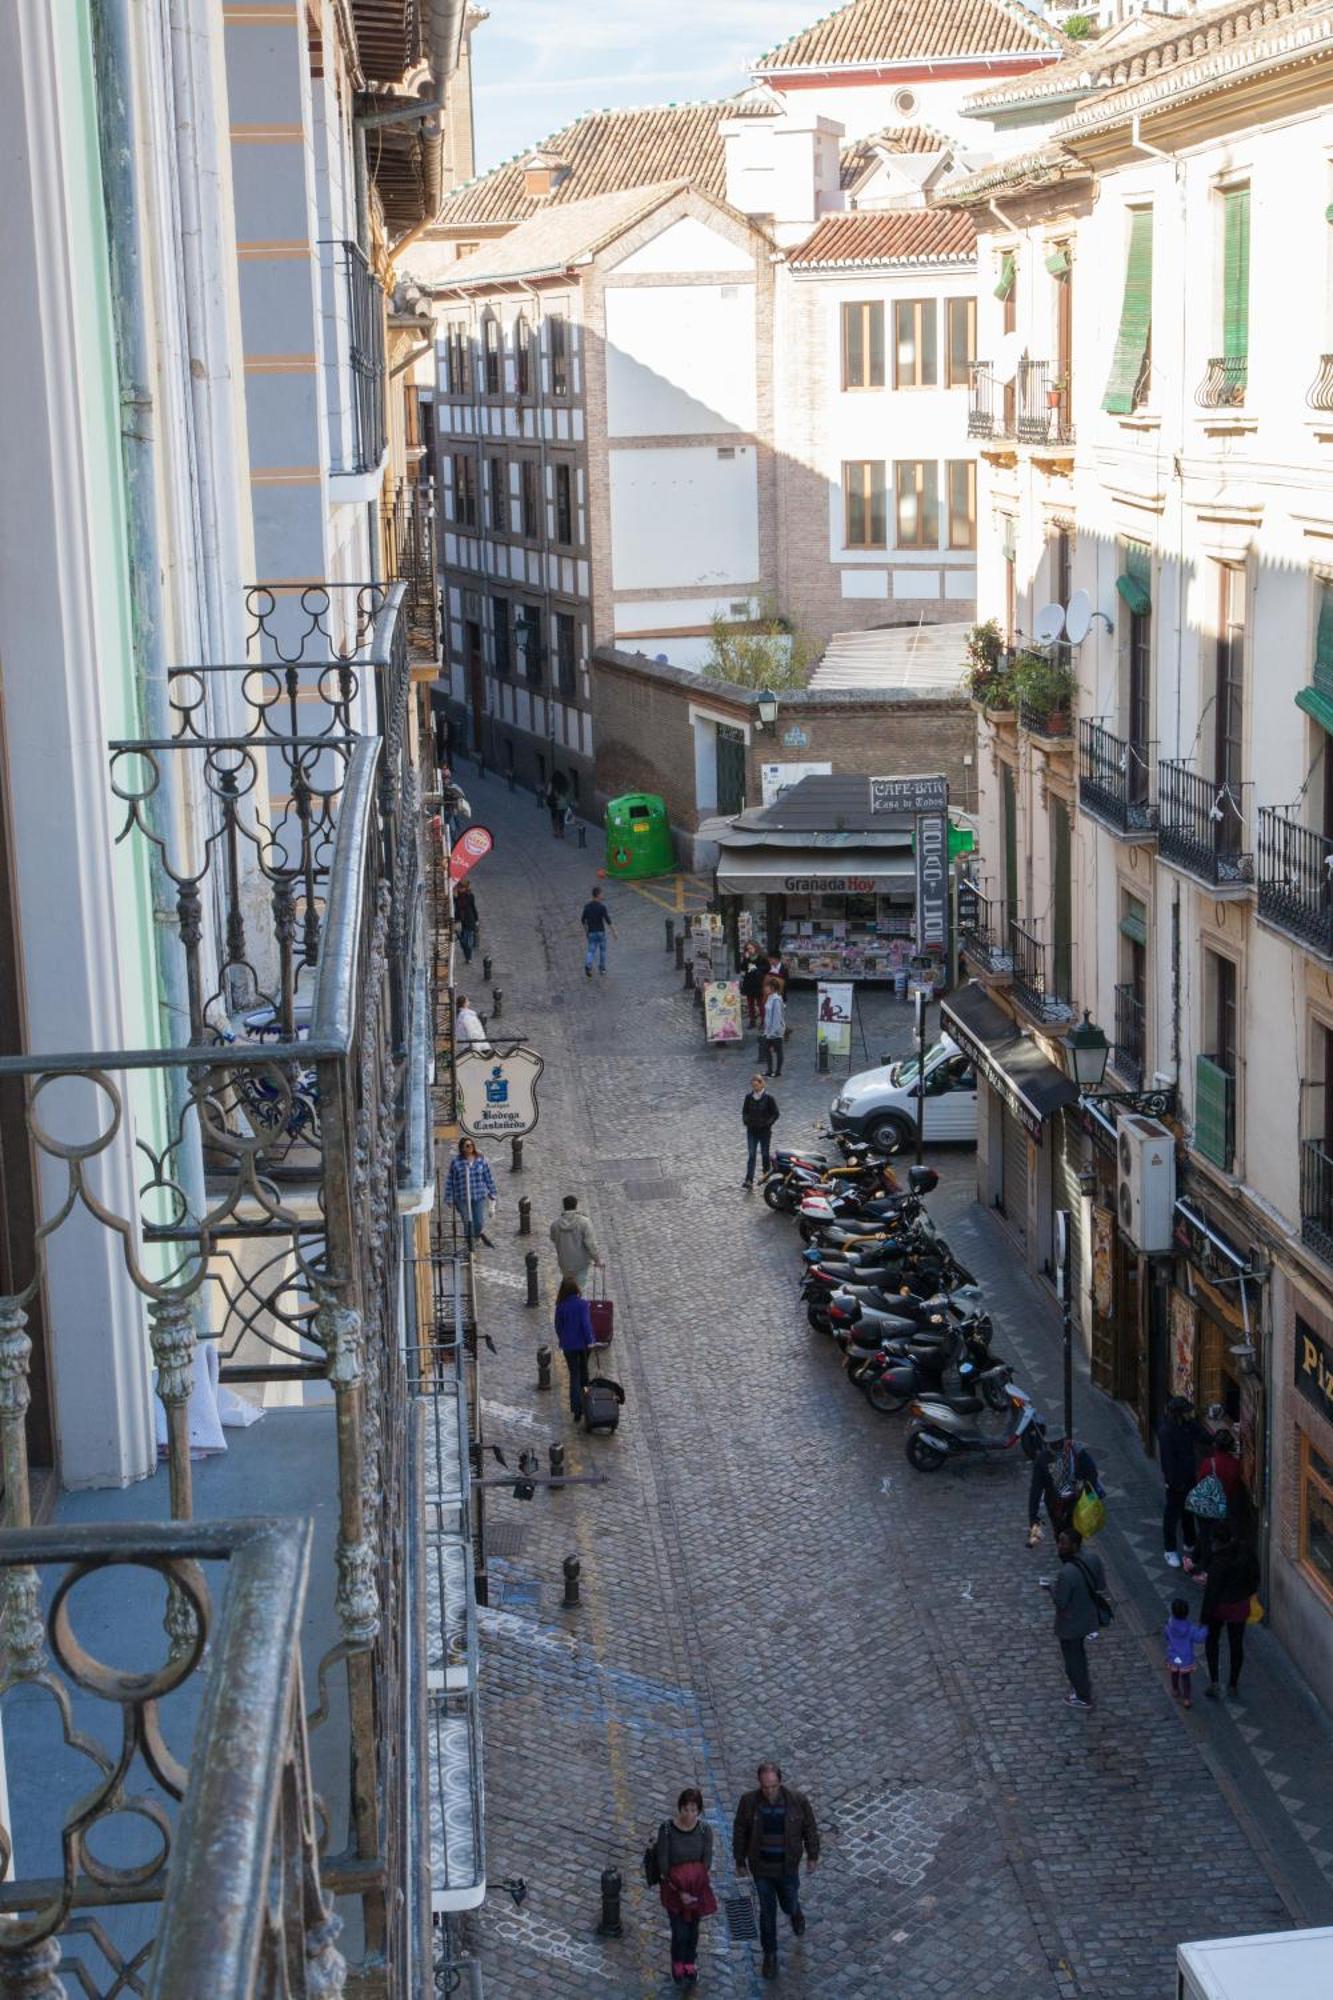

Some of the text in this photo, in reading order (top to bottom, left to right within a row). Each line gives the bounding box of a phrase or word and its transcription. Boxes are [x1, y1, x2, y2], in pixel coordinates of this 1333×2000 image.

[784, 876, 877, 893] Granada Hoy
[481, 1110, 520, 1120] Bodega
[473, 1120, 526, 1130] Castañeda
